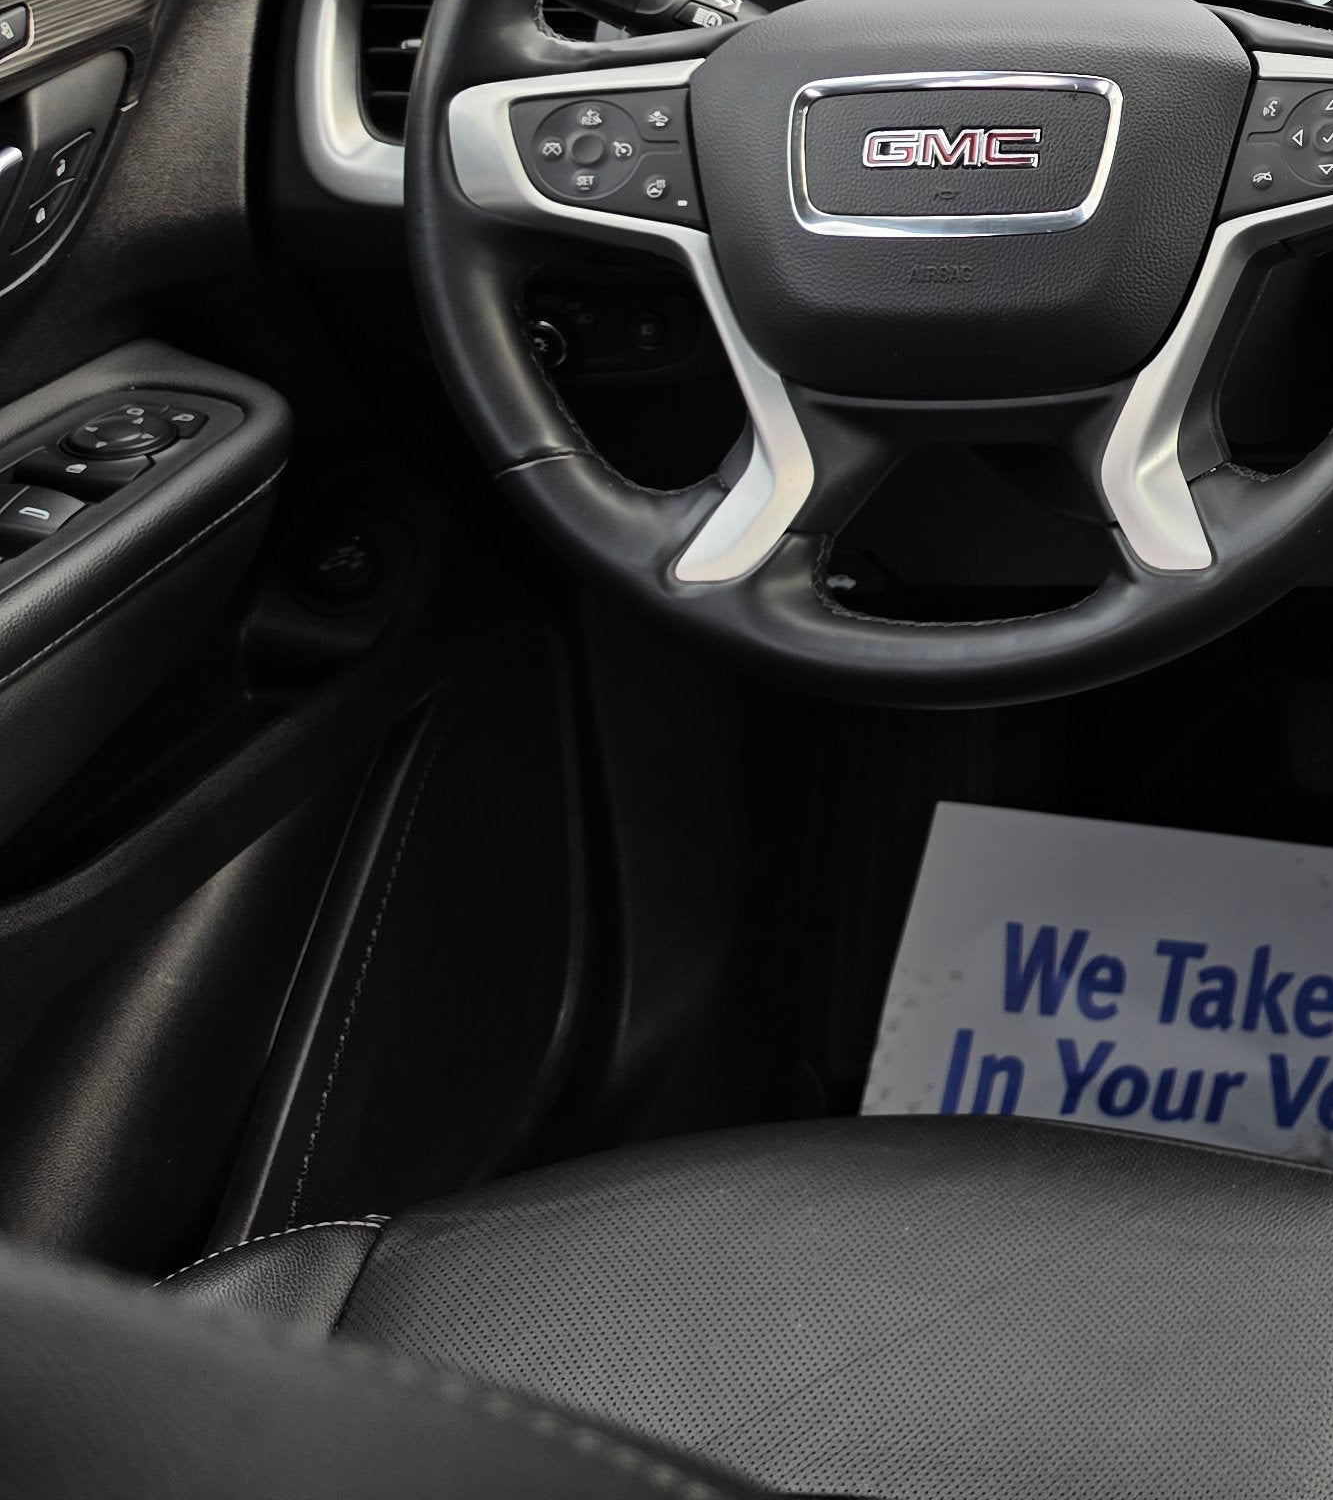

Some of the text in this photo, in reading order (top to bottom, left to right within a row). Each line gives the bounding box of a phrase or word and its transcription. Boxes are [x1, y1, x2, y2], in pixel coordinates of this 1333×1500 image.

[576, 175, 595, 186] SET
[862, 127, 1042, 168] GMC
[1003, 921, 1126, 1020] We
[938, 1027, 1025, 1115] In
[1056, 1039, 1247, 1123] Your
